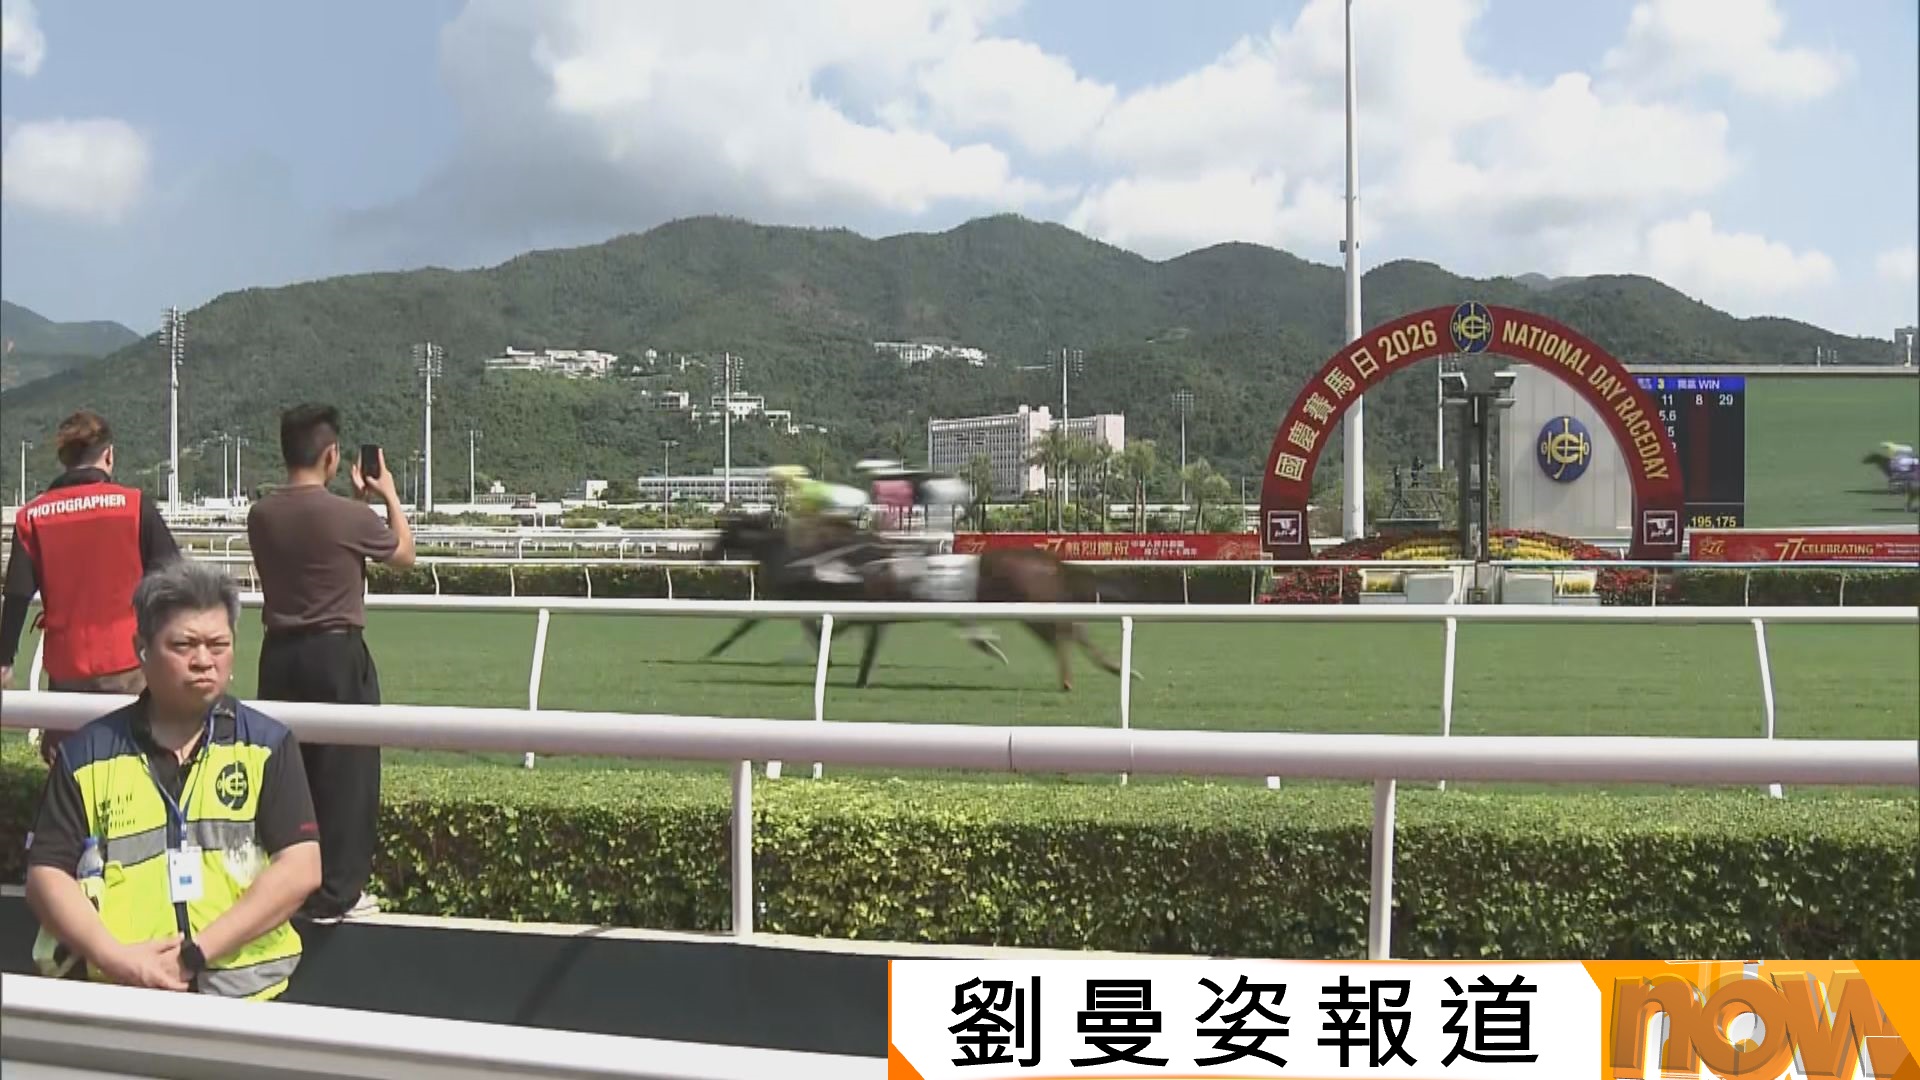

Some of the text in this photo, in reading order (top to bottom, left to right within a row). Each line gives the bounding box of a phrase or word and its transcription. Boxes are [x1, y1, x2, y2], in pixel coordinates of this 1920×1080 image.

[1698, 379, 1720, 389] WIN
[1275, 320, 1437, 481] 國慶賽馬日 2026
[1502, 320, 1670, 480] NATIONAL DAY RACEDAY
[1661, 394, 1673, 405] 11
[1695, 394, 1703, 405] 8
[27, 494, 126, 521] PHOTOGRAPHER
[1774, 538, 1805, 561] 77
[1801, 544, 1874, 555] CELEBRATING
